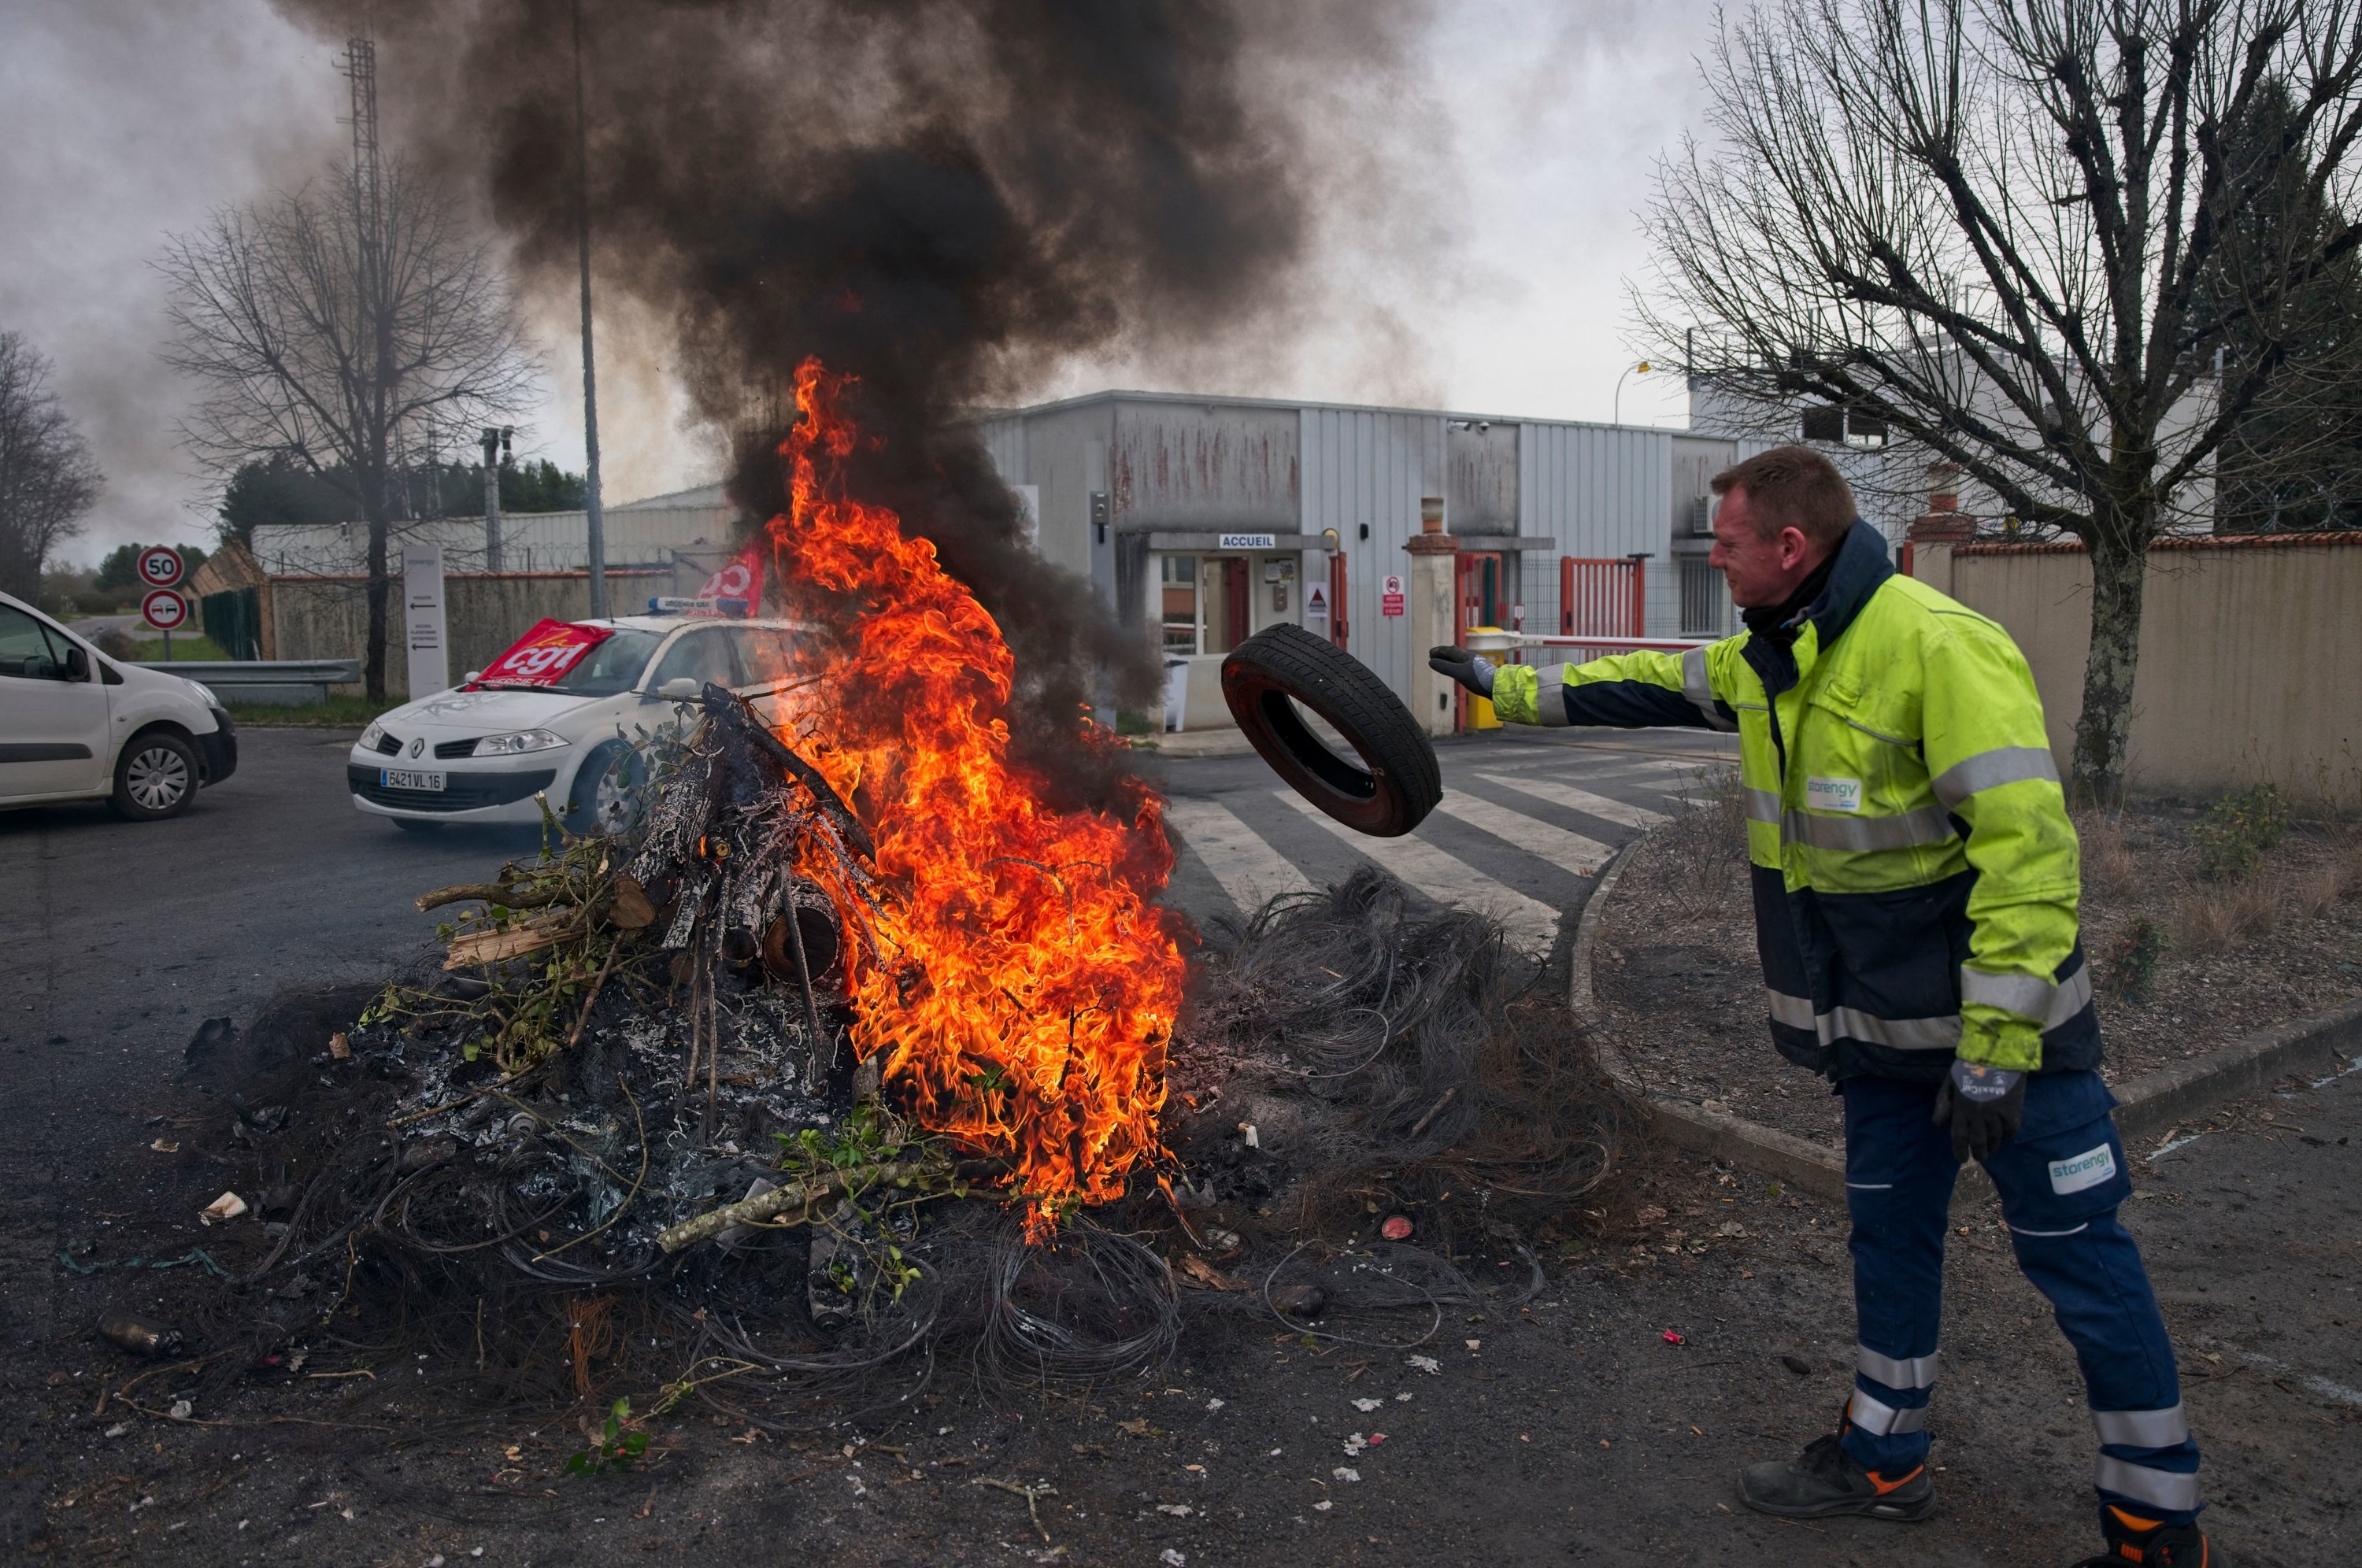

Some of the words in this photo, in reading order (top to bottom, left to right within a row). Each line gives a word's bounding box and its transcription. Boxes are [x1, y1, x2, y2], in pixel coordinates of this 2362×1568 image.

[1223, 537, 1273, 546] ACCUEIL
[149, 559, 175, 575] 50
[503, 642, 589, 675] cgt
[390, 772, 412, 786] 6421
[413, 774, 426, 788] VL
[428, 775, 440, 789] 16
[1808, 780, 1857, 797] storengy
[2053, 1150, 2109, 1178] storengy
